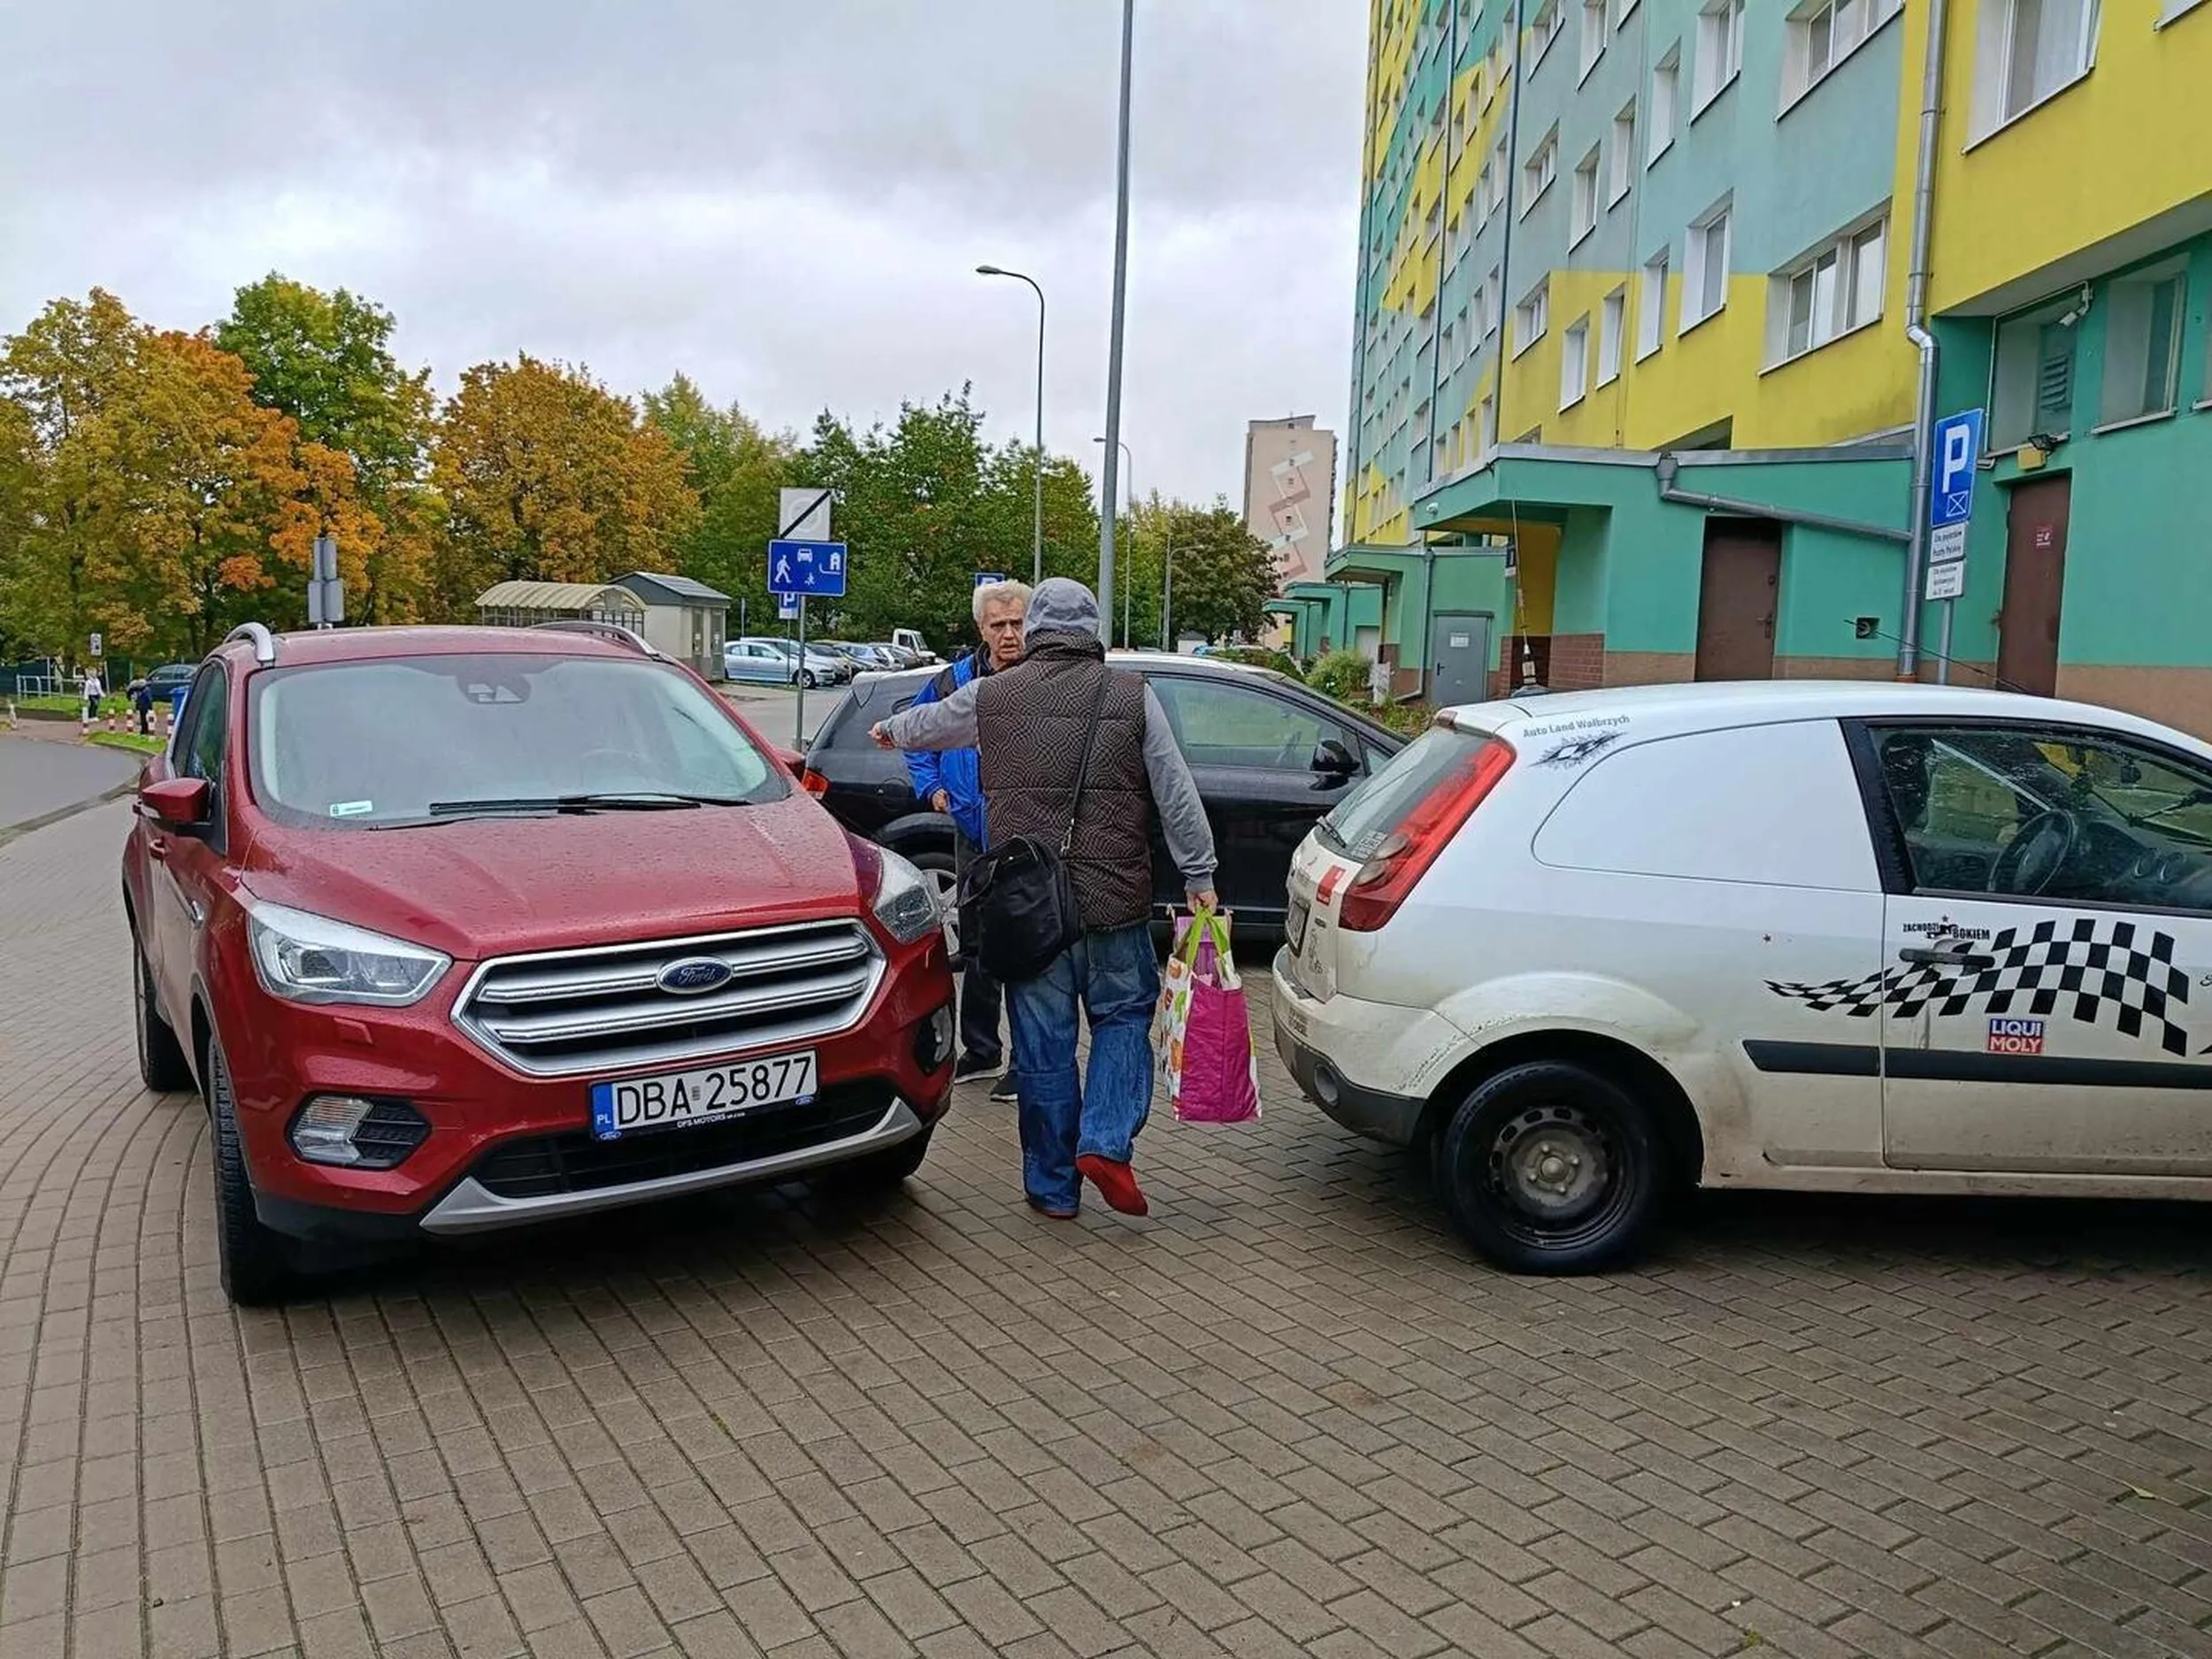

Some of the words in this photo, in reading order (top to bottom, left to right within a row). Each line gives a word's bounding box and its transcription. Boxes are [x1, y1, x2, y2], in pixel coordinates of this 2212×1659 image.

[1942, 423, 1970, 494] P
[1523, 727, 1548, 738] Auto
[1549, 722, 1575, 733] Land
[1952, 926, 1990, 940] BOKIEM
[1992, 1019, 2042, 1037] LIQUI
[1990, 1036, 2041, 1052] MOLY
[596, 1113, 611, 1125] PL
[617, 1079, 692, 1125] DBA
[705, 1056, 811, 1110] 25877
